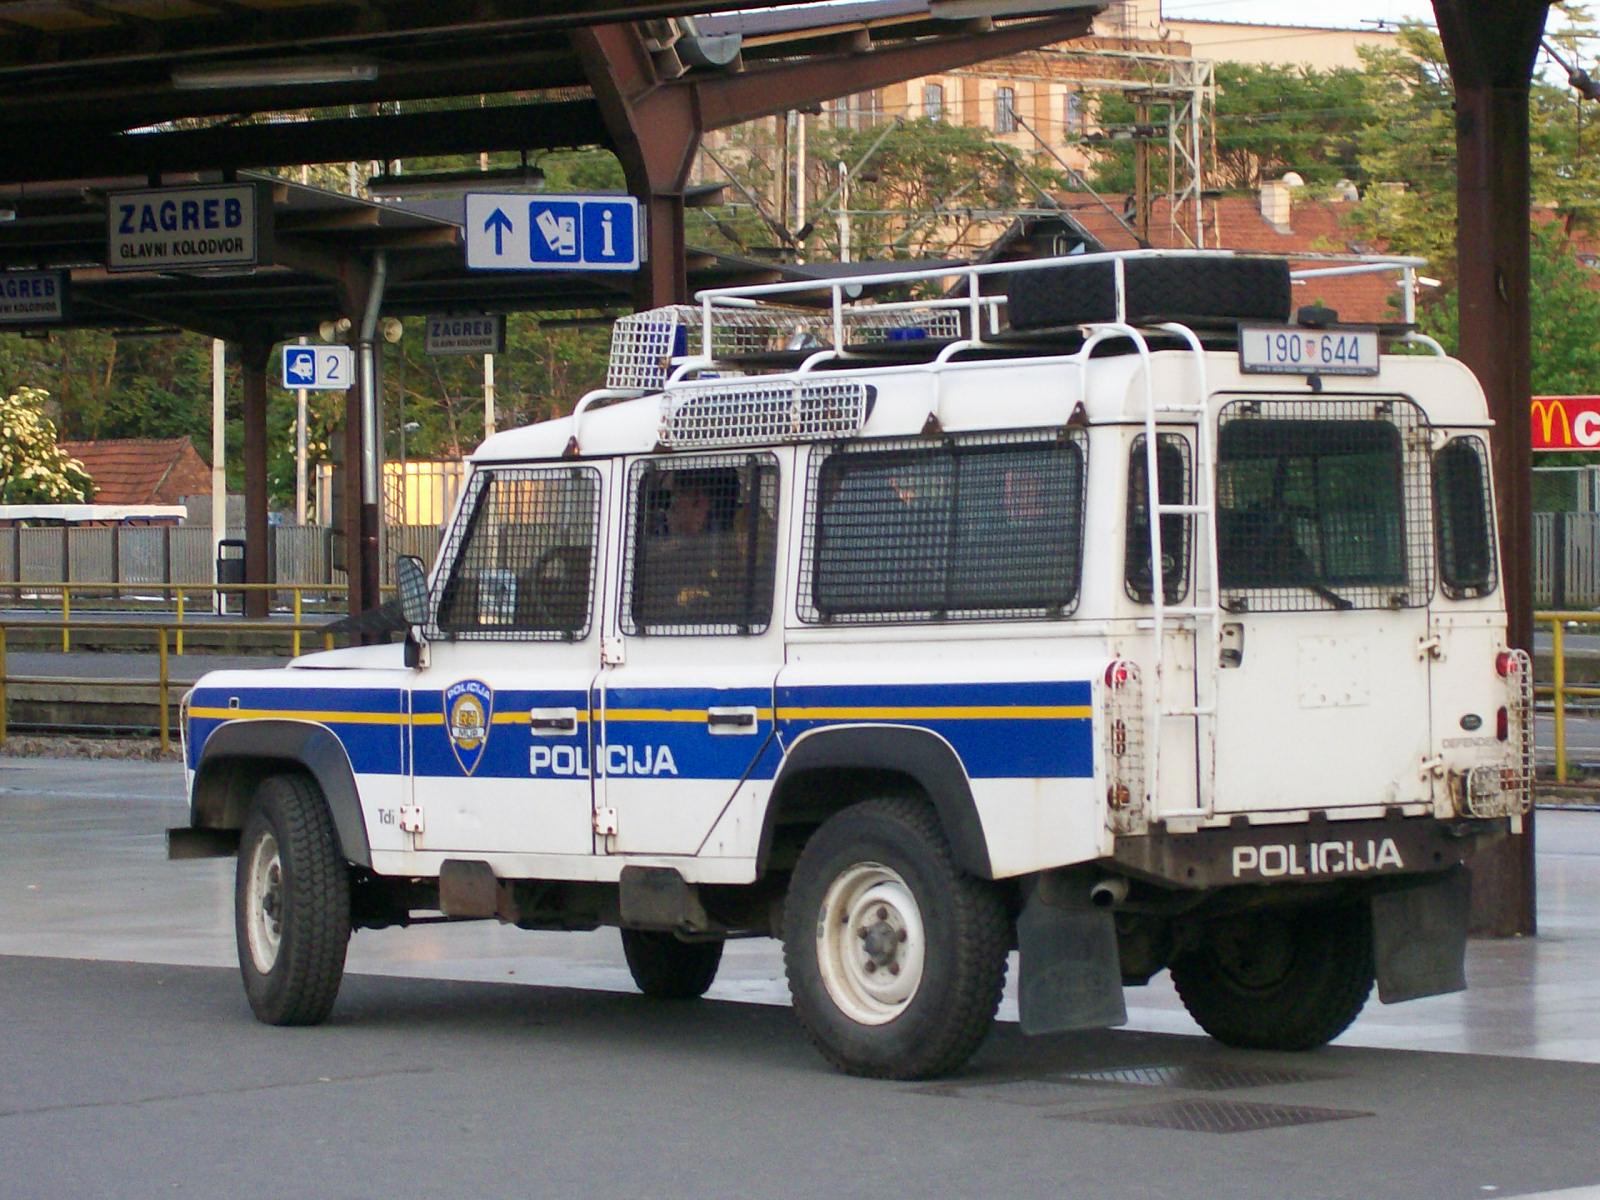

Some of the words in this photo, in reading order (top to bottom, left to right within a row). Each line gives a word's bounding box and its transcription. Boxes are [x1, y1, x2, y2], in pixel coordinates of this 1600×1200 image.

[118, 198, 242, 234] ZAGREB
[120, 241, 167, 258] GLAVNI
[173, 237, 244, 257] KOLODVOR
[432, 321, 492, 337] ZAGREB
[1266, 334, 1301, 362] 190
[1321, 335, 1359, 363] 644
[326, 355, 339, 379] 2
[447, 682, 490, 700] POLICIJA
[529, 744, 678, 776] POLICIJA
[378, 808, 395, 825] Tdi
[1232, 838, 1404, 877] POLICIJA
